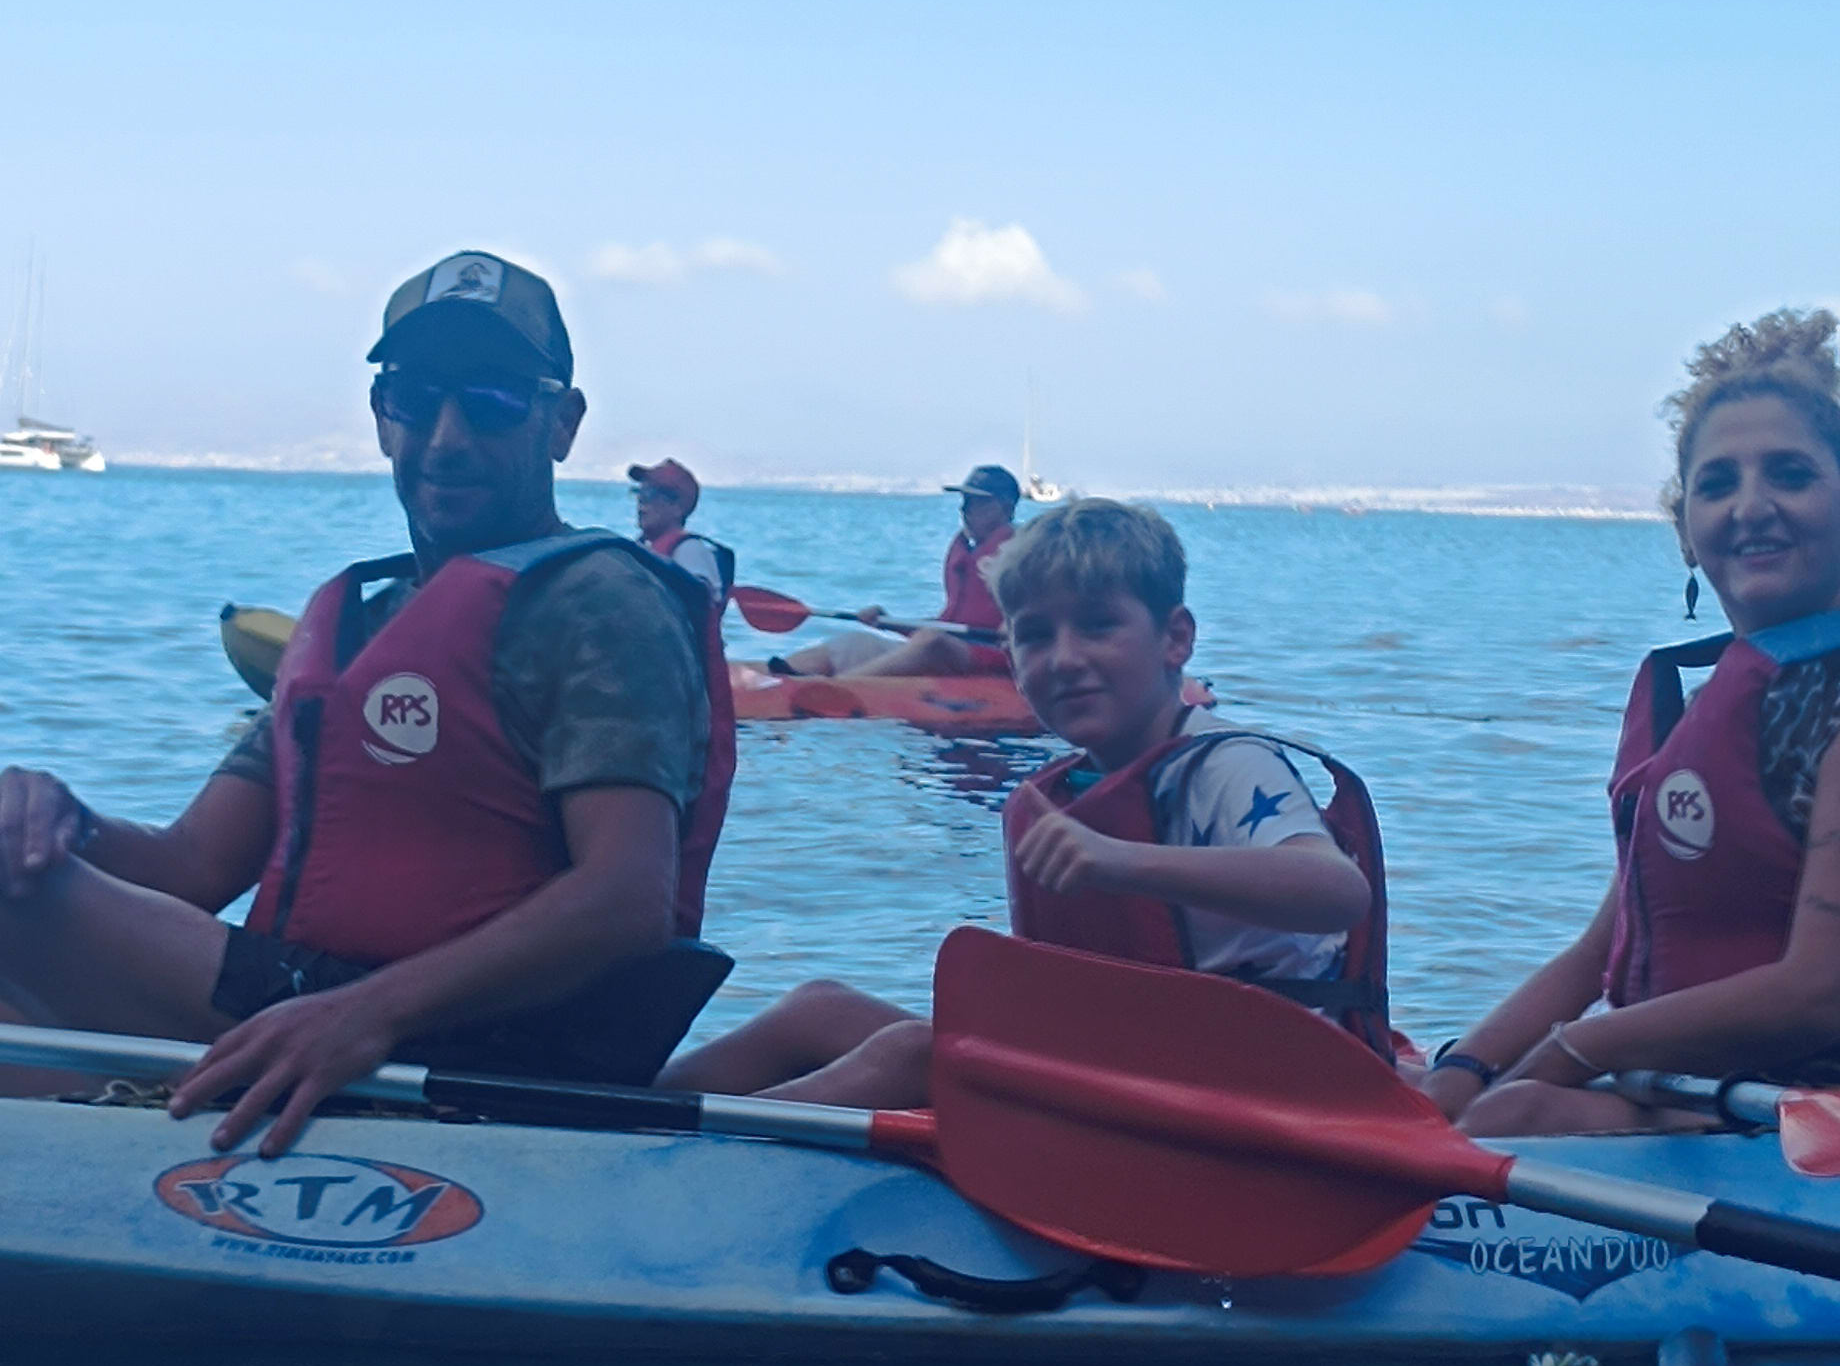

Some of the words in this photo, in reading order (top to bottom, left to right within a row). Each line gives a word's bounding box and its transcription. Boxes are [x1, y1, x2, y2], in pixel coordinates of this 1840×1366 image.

[381, 694, 431, 727] RPS
[1667, 790, 1705, 821] RPS
[175, 1175, 449, 1231] RTM
